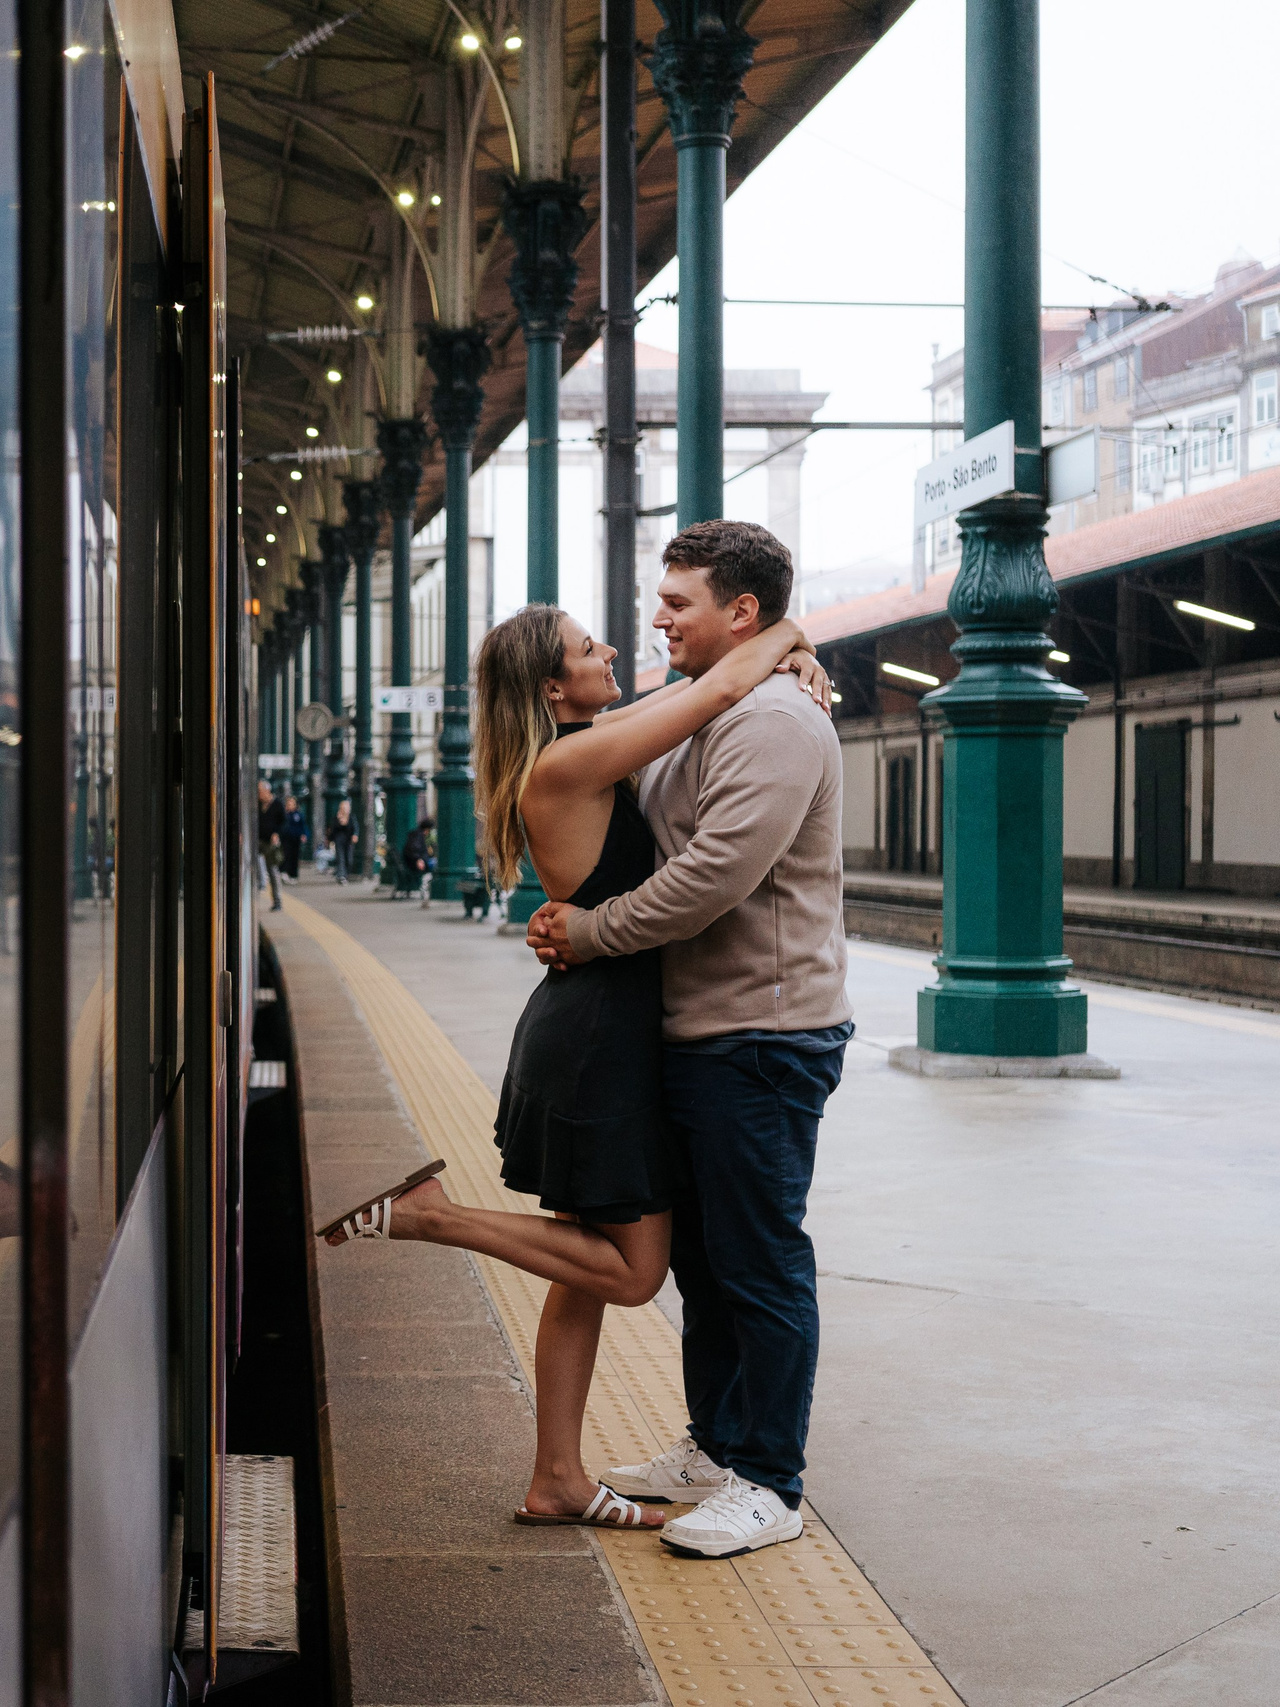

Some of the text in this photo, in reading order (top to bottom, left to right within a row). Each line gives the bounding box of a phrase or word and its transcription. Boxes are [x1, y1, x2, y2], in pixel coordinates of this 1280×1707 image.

[925, 477, 946, 504] Porto
[952, 466, 969, 491] São
[971, 453, 998, 482] Bento
